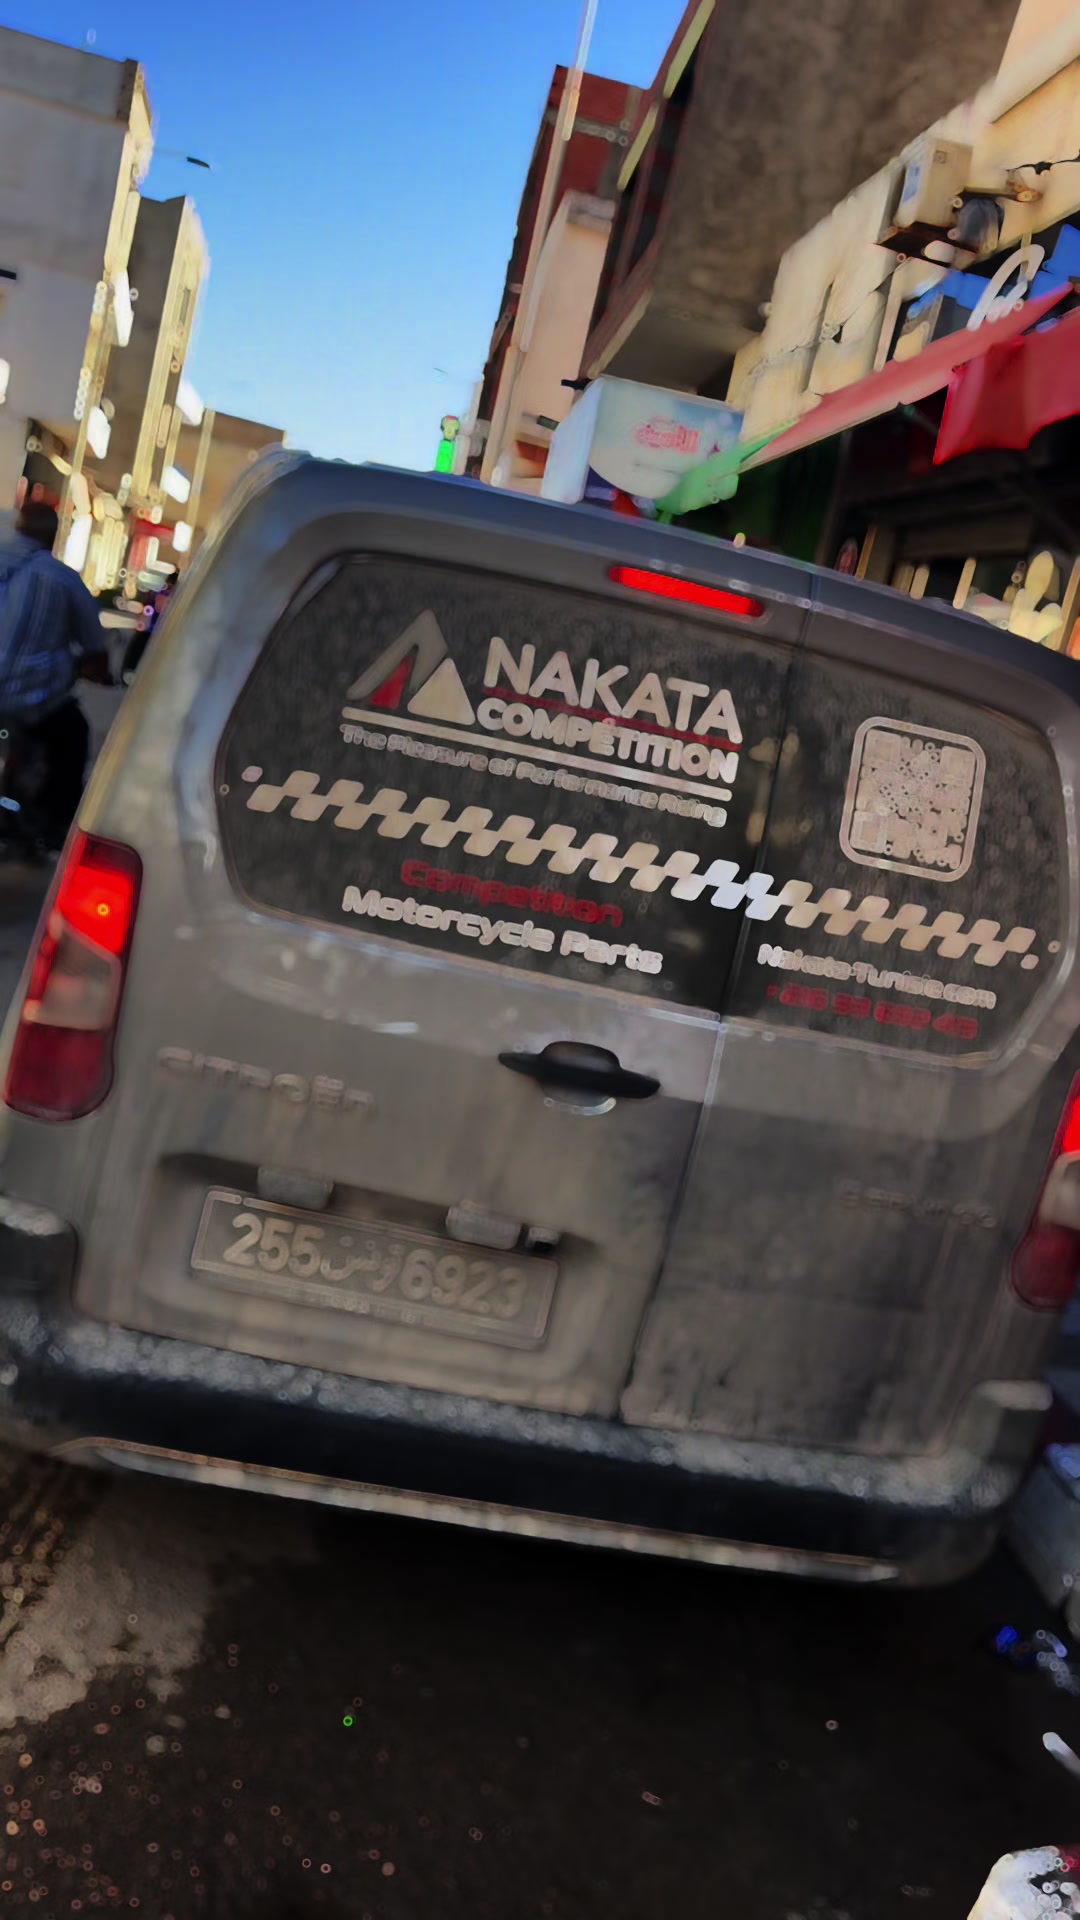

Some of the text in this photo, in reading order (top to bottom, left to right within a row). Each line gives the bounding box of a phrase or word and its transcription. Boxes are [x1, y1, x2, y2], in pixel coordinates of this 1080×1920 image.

[483, 636, 743, 744] NAKATA
[477, 697, 740, 784] COMPETITION
[342, 885, 664, 975] Motorcycle Parts
[401, 860, 624, 928] Competition
[223, 1212, 326, 1278] 255
[401, 1248, 528, 1319] 6923
